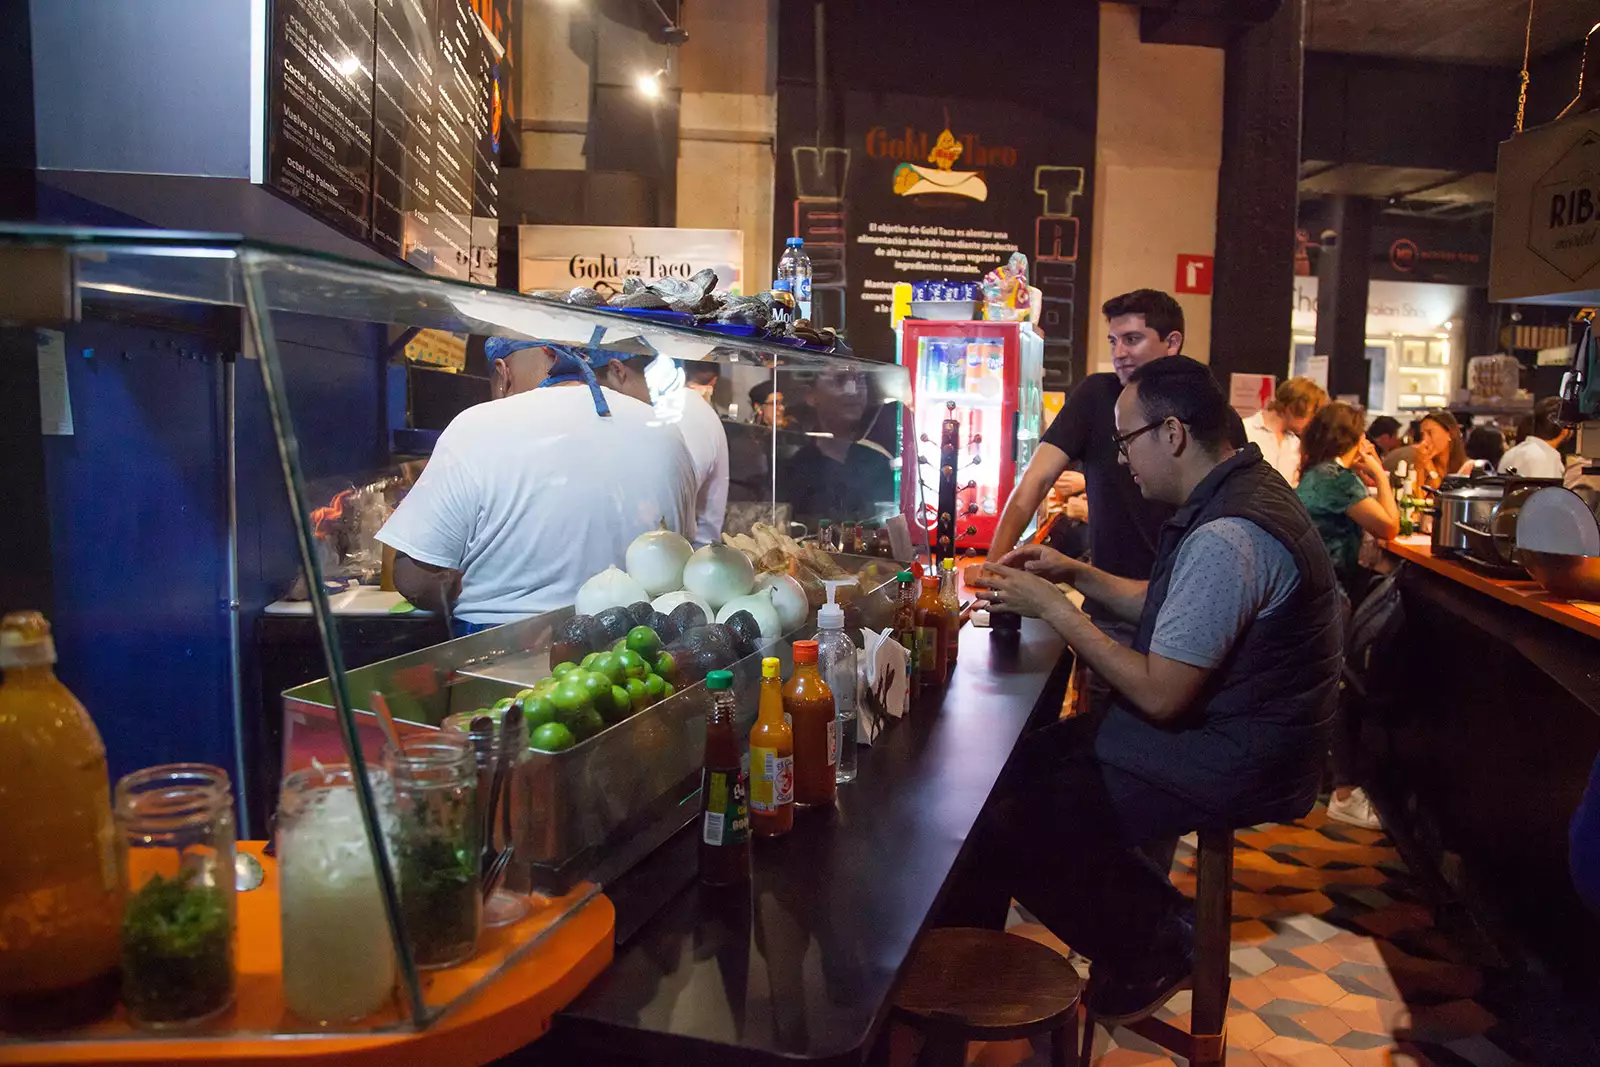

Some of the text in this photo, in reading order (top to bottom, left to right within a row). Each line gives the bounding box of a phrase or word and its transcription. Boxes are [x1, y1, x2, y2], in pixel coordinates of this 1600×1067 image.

[309, 32, 316, 48] de
[284, 58, 370, 146] Coctel de Camarón con Ostión
[283, 105, 335, 152] Vuelve a la Vida
[865, 126, 1017, 166] Gold Taco
[306, 167, 314, 181] de
[315, 174, 338, 197] Palmito
[1550, 187, 1600, 229] RIB
[869, 223, 877, 232] El
[878, 224, 909, 234] objetivo
[910, 226, 920, 234] de
[921, 226, 938, 236] Gold
[939, 227, 955, 237] Taco
[956, 230, 965, 238] es
[993, 232, 1008, 240] una
[857, 234, 1018, 252] alimentación saludable mediante productos
[875, 247, 886, 256] de
[886, 248, 901, 257] alta
[903, 249, 930, 258] calidad
[930, 251, 941, 259] de
[941, 252, 966, 262] origen
[967, 253, 995, 263] vegetal
[569, 254, 691, 279] Gold Taco
[894, 260, 980, 274] ingredientes naturales.
[864, 279, 897, 289] Manten
